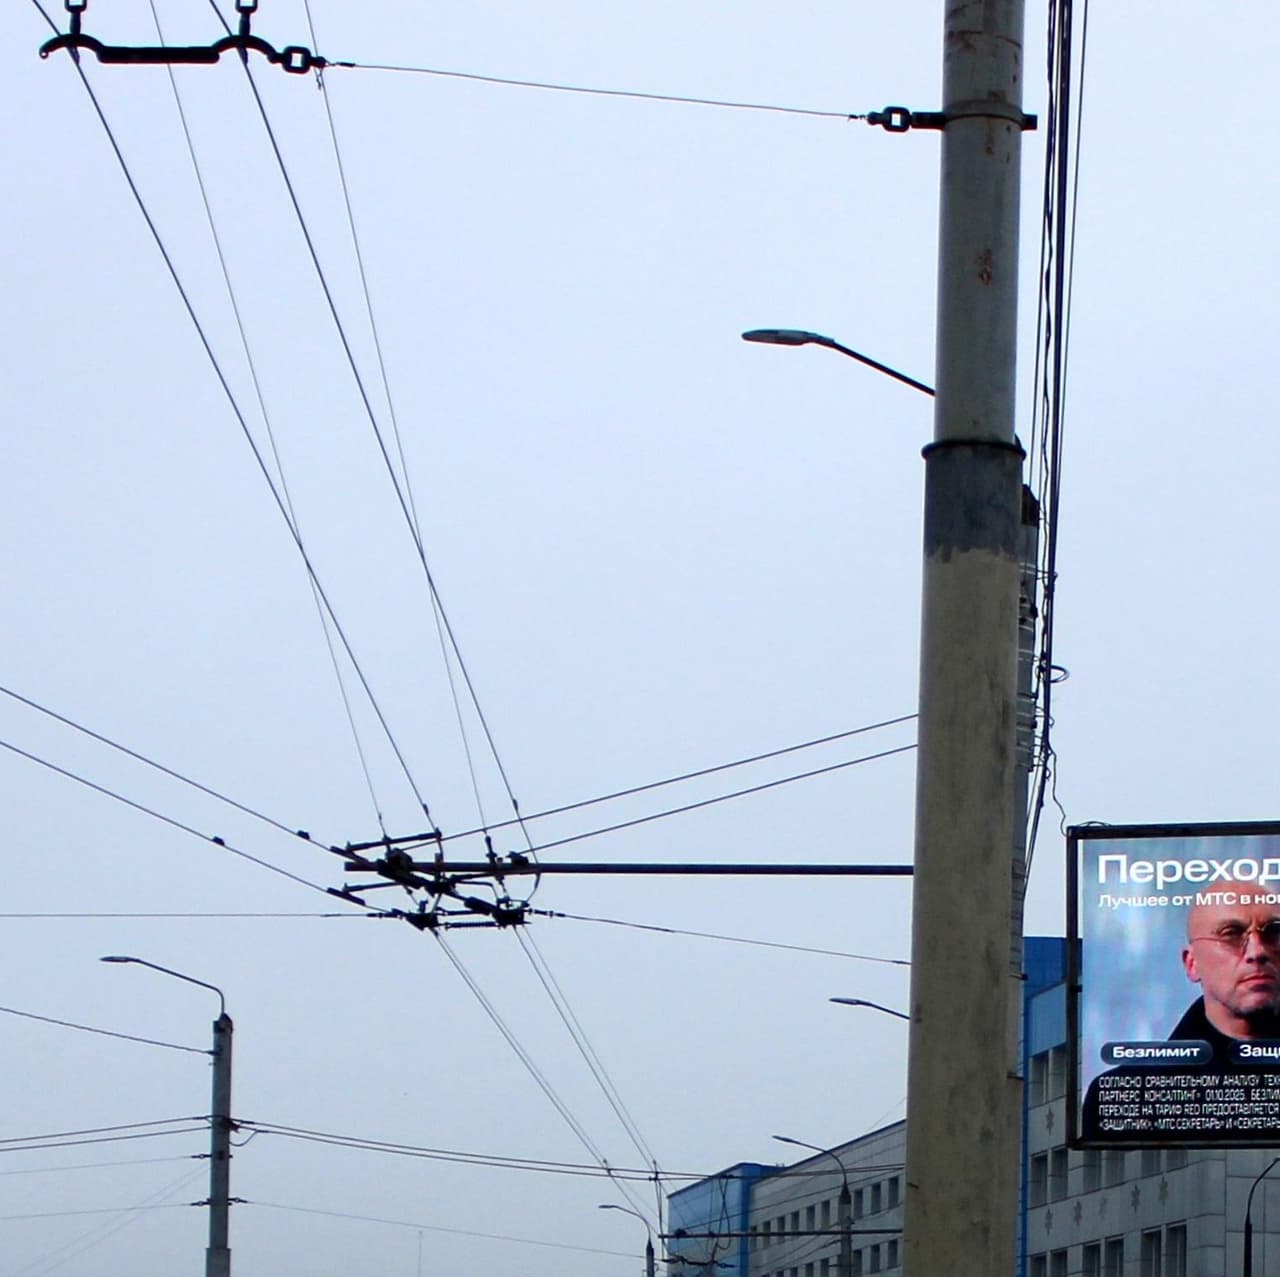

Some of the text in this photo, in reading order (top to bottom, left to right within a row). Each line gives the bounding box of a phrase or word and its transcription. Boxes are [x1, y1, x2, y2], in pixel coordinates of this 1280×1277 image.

[1098, 894, 1167, 909] Лучшее
[1172, 895, 1192, 906] от
[1196, 891, 1237, 906] МТС
[1240, 894, 1252, 905] в
[1112, 1046, 1200, 1059] Безлимит
[1099, 1076, 1141, 1088] СОГЛАСНО
[1145, 1075, 1220, 1087] СРАВНИТЕЛЬНОМУ
[1223, 1074, 1260, 1086] АНАЛИЗУ
[1099, 1090, 1140, 1102] ПАРТНЕРС
[1144, 1089, 1200, 1101] КОНСАЛТИНГ»
[1099, 1104, 1140, 1117] ПЕРЕХОДЕ
[1141, 1104, 1153, 1116] НА
[1155, 1103, 1182, 1116] ТАРИФ
[1184, 1103, 1200, 1115] RED
[1202, 1102, 1279, 1116] ПРЕДОСТАВЛЯЕТСЯ
[1099, 1118, 1153, 1131] «ЗАЩИТНИК»,
[1226, 1117, 1233, 1129] И
